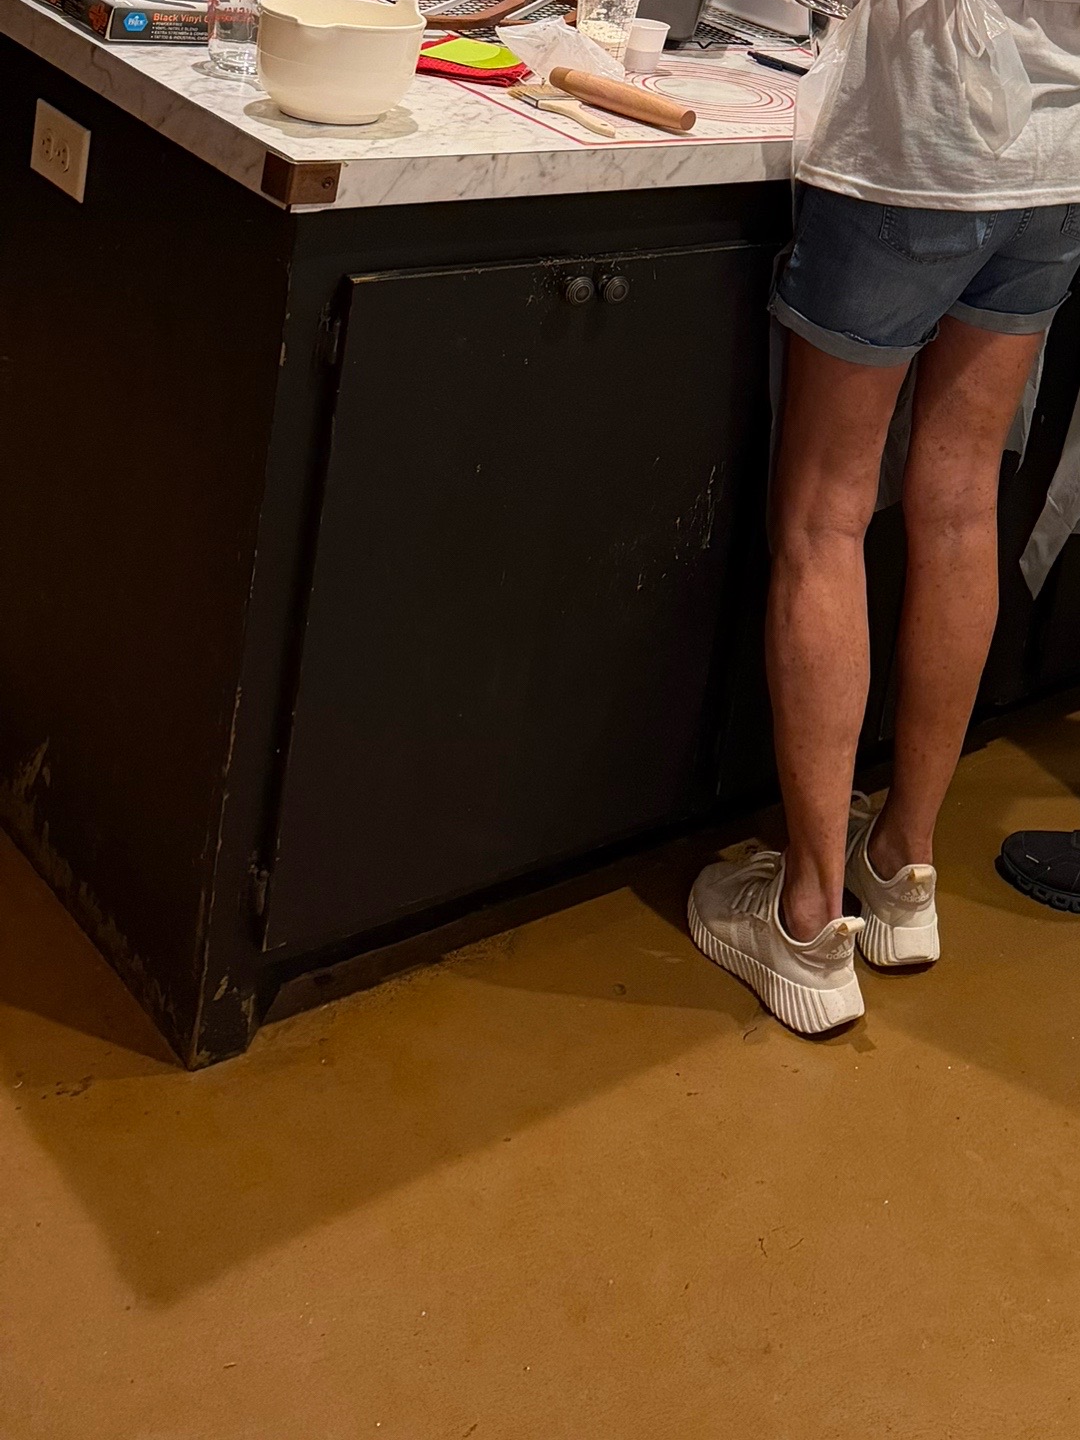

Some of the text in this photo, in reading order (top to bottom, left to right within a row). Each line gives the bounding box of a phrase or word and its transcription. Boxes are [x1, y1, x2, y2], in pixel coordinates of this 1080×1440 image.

[153, 13, 179, 22] Black
[181, 14, 202, 24] Vinyl
[826, 949, 851, 960] adida
